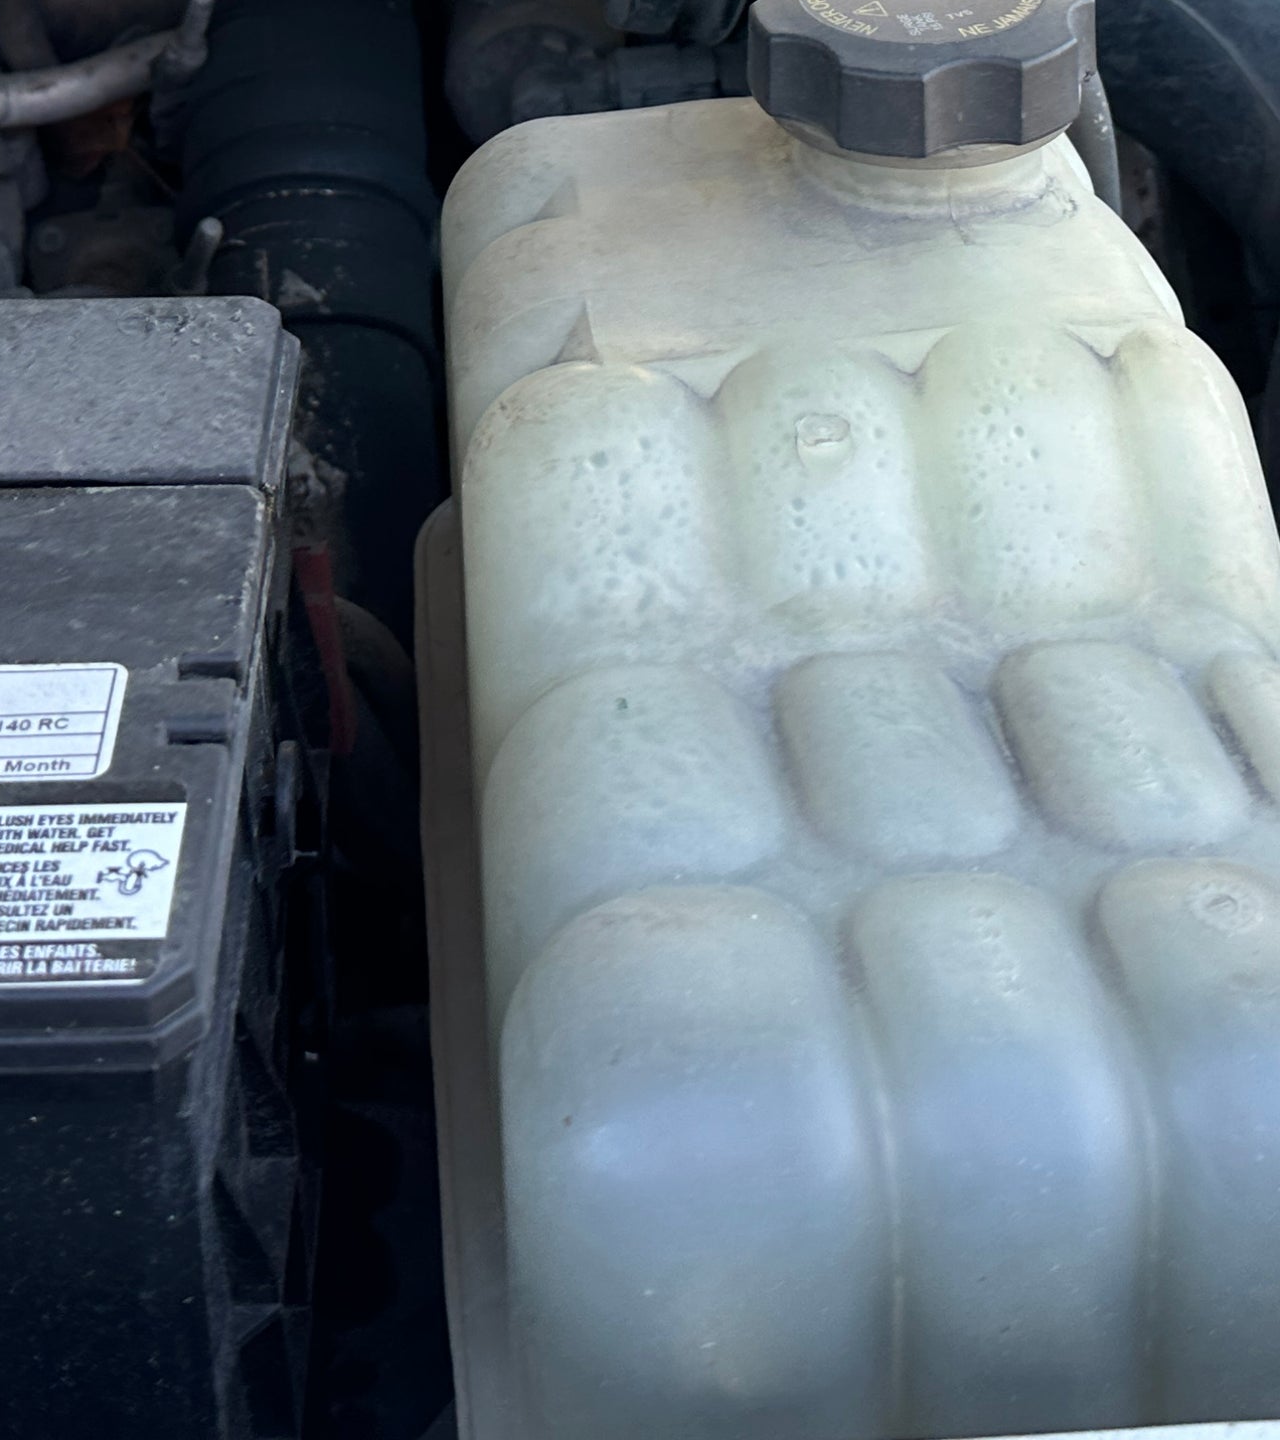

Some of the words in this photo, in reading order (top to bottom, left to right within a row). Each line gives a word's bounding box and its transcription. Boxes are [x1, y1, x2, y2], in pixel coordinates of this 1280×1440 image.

[820, 8, 878, 35] NEVER
[958, 23, 993, 38] NE
[38, 717, 70, 730] RC
[4, 759, 71, 772] Month
[37, 814, 75, 825] EYES
[78, 811, 179, 825] IMMEDIATELY
[27, 827, 81, 840] WATER.
[86, 826, 116, 838] GET
[50, 841, 89, 853] HELP
[91, 840, 132, 852] FAST.
[32, 861, 61, 872] LES
[52, 904, 75, 916] UN
[23, 943, 102, 959] ENFANTS.
[25, 961, 48, 974] LA
[51, 957, 137, 973] BATTERIE!
